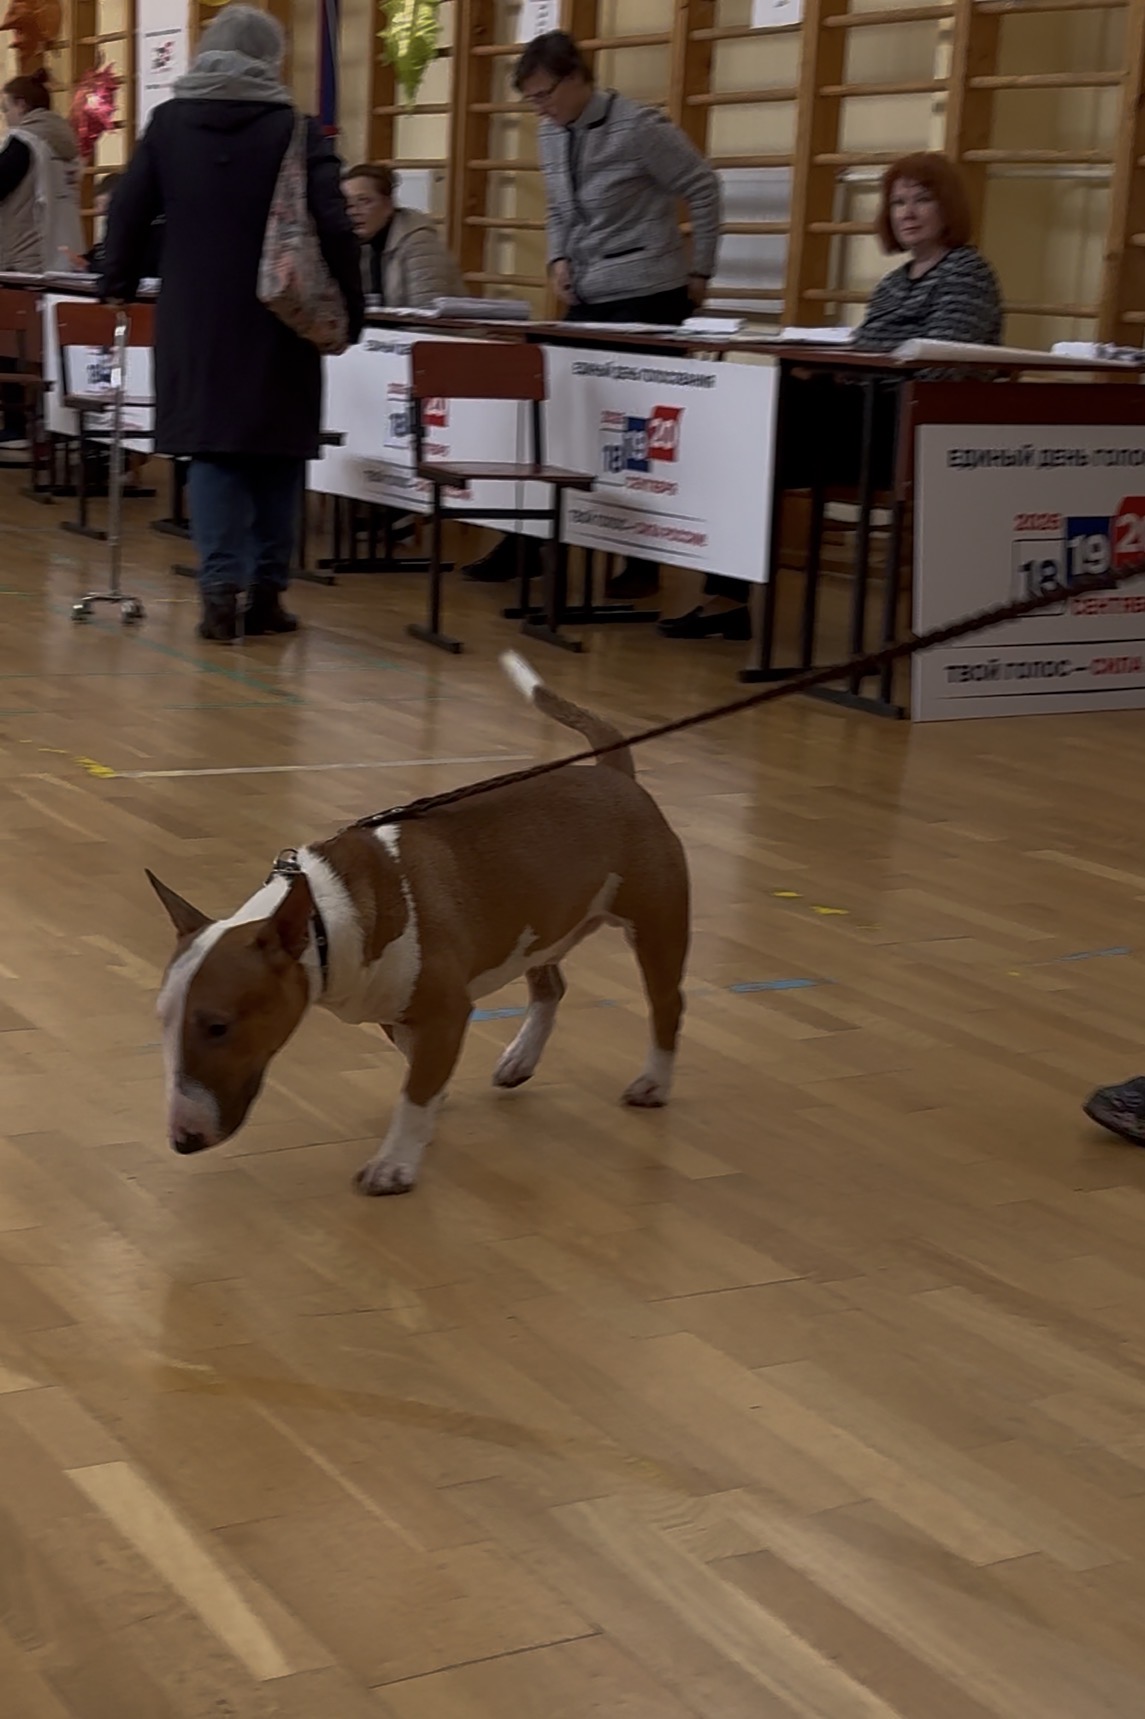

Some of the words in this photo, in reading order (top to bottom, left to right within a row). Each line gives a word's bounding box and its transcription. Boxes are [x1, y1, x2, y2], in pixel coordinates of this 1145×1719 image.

[947, 444, 1032, 469] ЕДИНЫЙ
[1036, 449, 1088, 469] ДЕНЬ
[1066, 533, 1111, 576] 19
[1018, 559, 1058, 599] 18
[945, 658, 1000, 683] ТВОЙ
[1003, 660, 1072, 680] ГОЛОС
[1086, 656, 1141, 676] СИЛА
